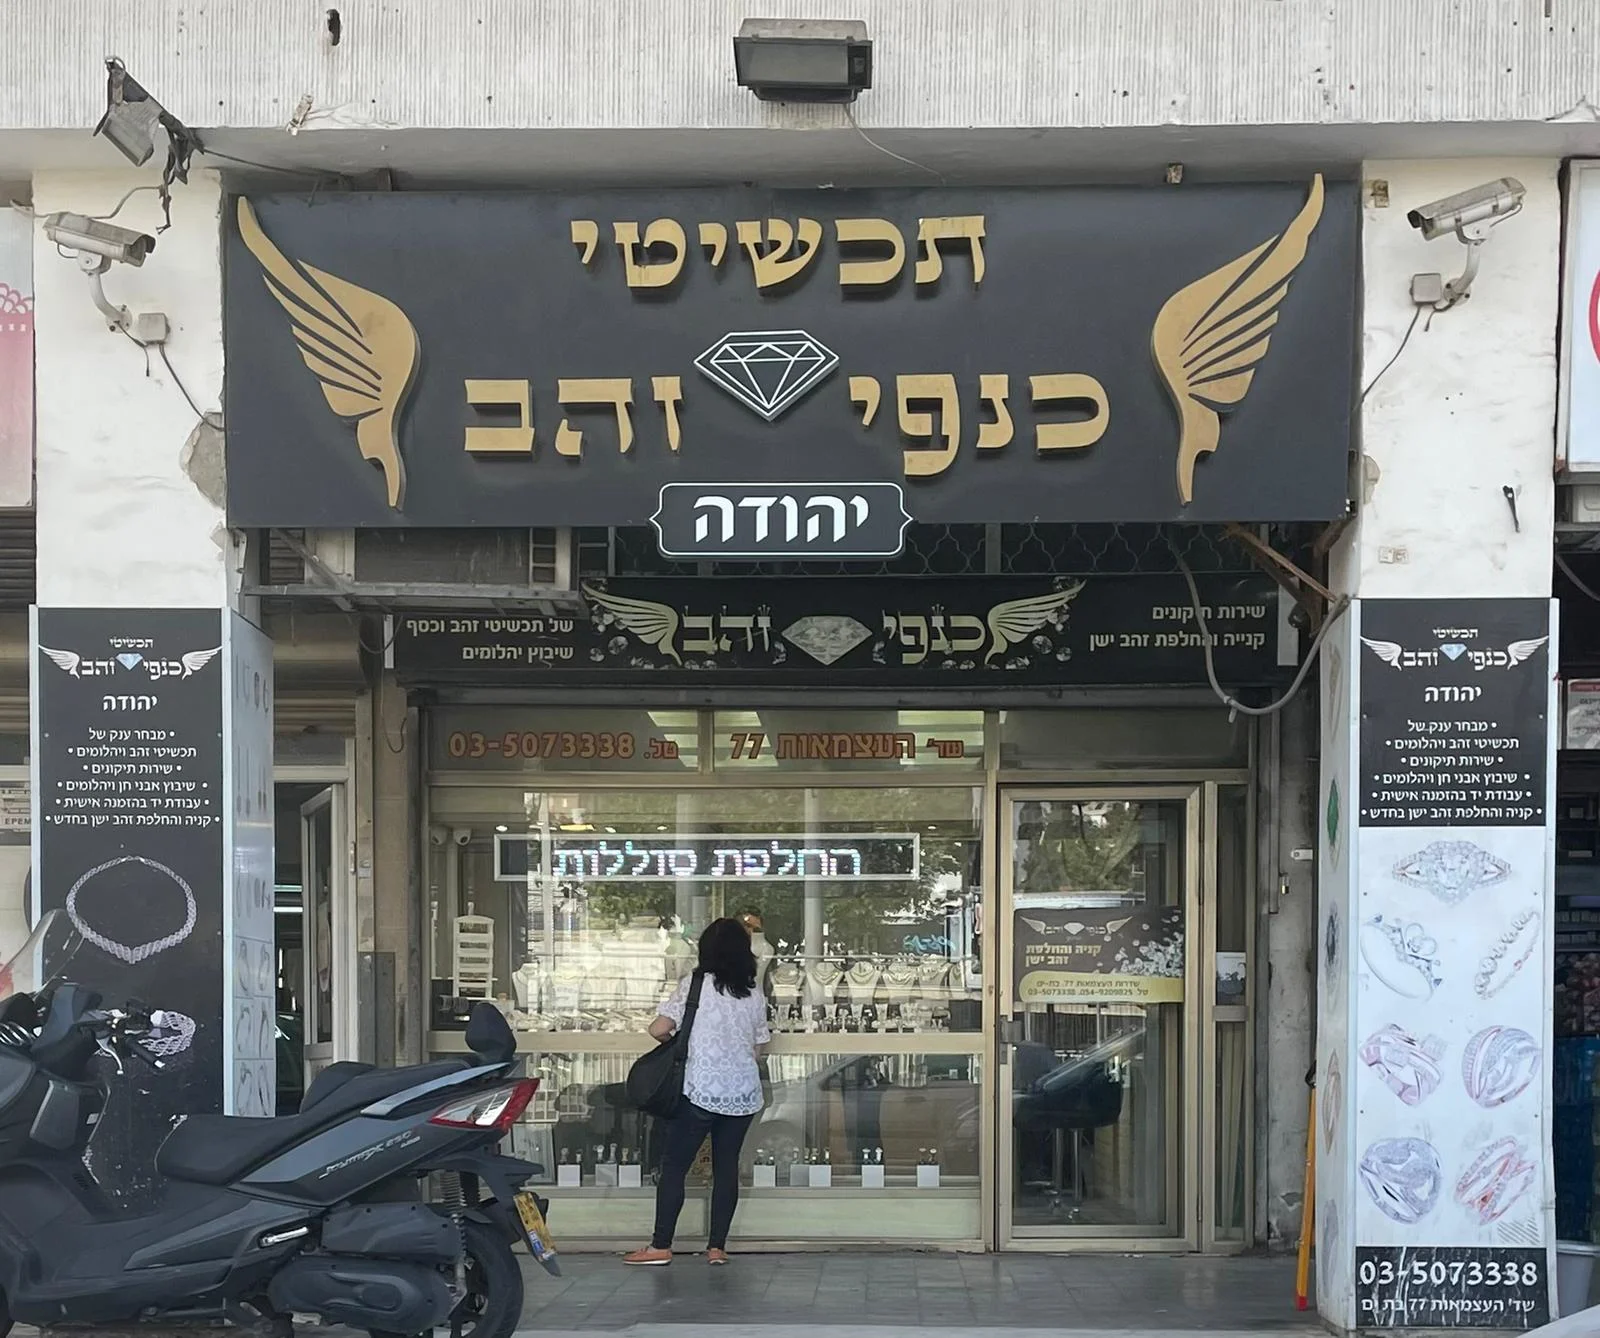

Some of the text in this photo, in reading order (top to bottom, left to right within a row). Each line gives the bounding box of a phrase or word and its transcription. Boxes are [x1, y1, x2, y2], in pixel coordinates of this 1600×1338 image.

[571, 215, 986, 288] תכשיטי
[464, 374, 1110, 476] כנפי זהב
[693, 495, 869, 543] יהודה
[1217, 605, 1266, 619] שירות
[406, 618, 574, 637] של תכשיטי זהב וכסף
[683, 605, 985, 665] כנפי זהב
[1432, 627, 1478, 639] תכשיטי
[109, 636, 154, 648] תכשיטי
[1089, 634, 1115, 652] ישן
[1119, 634, 1150, 647] זהב
[1223, 633, 1265, 650] קנייה
[462, 644, 574, 664] שיבוץ יהלומים
[1402, 648, 1509, 671] כנפי זהב
[81, 657, 183, 681] כנפי זהב
[1425, 686, 1482, 702] יהודה
[103, 695, 158, 711] יהודה
[1407, 719, 1488, 733] מבחר ענק של
[88, 727, 166, 742] מבחר ענק של
[448, 731, 679, 760] טל. 03-5073338
[730, 732, 965, 760] שד' העצמאות 77
[1394, 736, 1519, 749] תכשיטי זהב ויהלומים
[76, 744, 197, 758] תכשיטי זהב ויהלומים
[91, 763, 173, 775] שירות תיקונים
[1410, 756, 1495, 768] שירות תיקונים
[66, 778, 196, 793] שיבוץ אבני חן ויהלומים
[1382, 771, 1518, 785] שיבוץ אבני חן ויהלומים
[63, 797, 201, 810] עבודת יד בהזמנה אישית
[1380, 790, 1523, 802] עבודת יד בהזמנה אישית
[53, 812, 212, 828] קניה והחלפת זהב ישן בחדש
[1369, 805, 1533, 820] קניה והחלפת זהב ישן בחדש
[552, 840, 862, 877] החלפת סוללות
[1026, 942, 1102, 957] קניה והחלפת
[1025, 955, 1069, 968] זהב ישן
[1359, 1260, 1538, 1287] 03-5073338
[1408, 1298, 1427, 1312] 77
[1430, 1298, 1505, 1314] העצמאות
[1507, 1298, 1536, 1313] שד'
